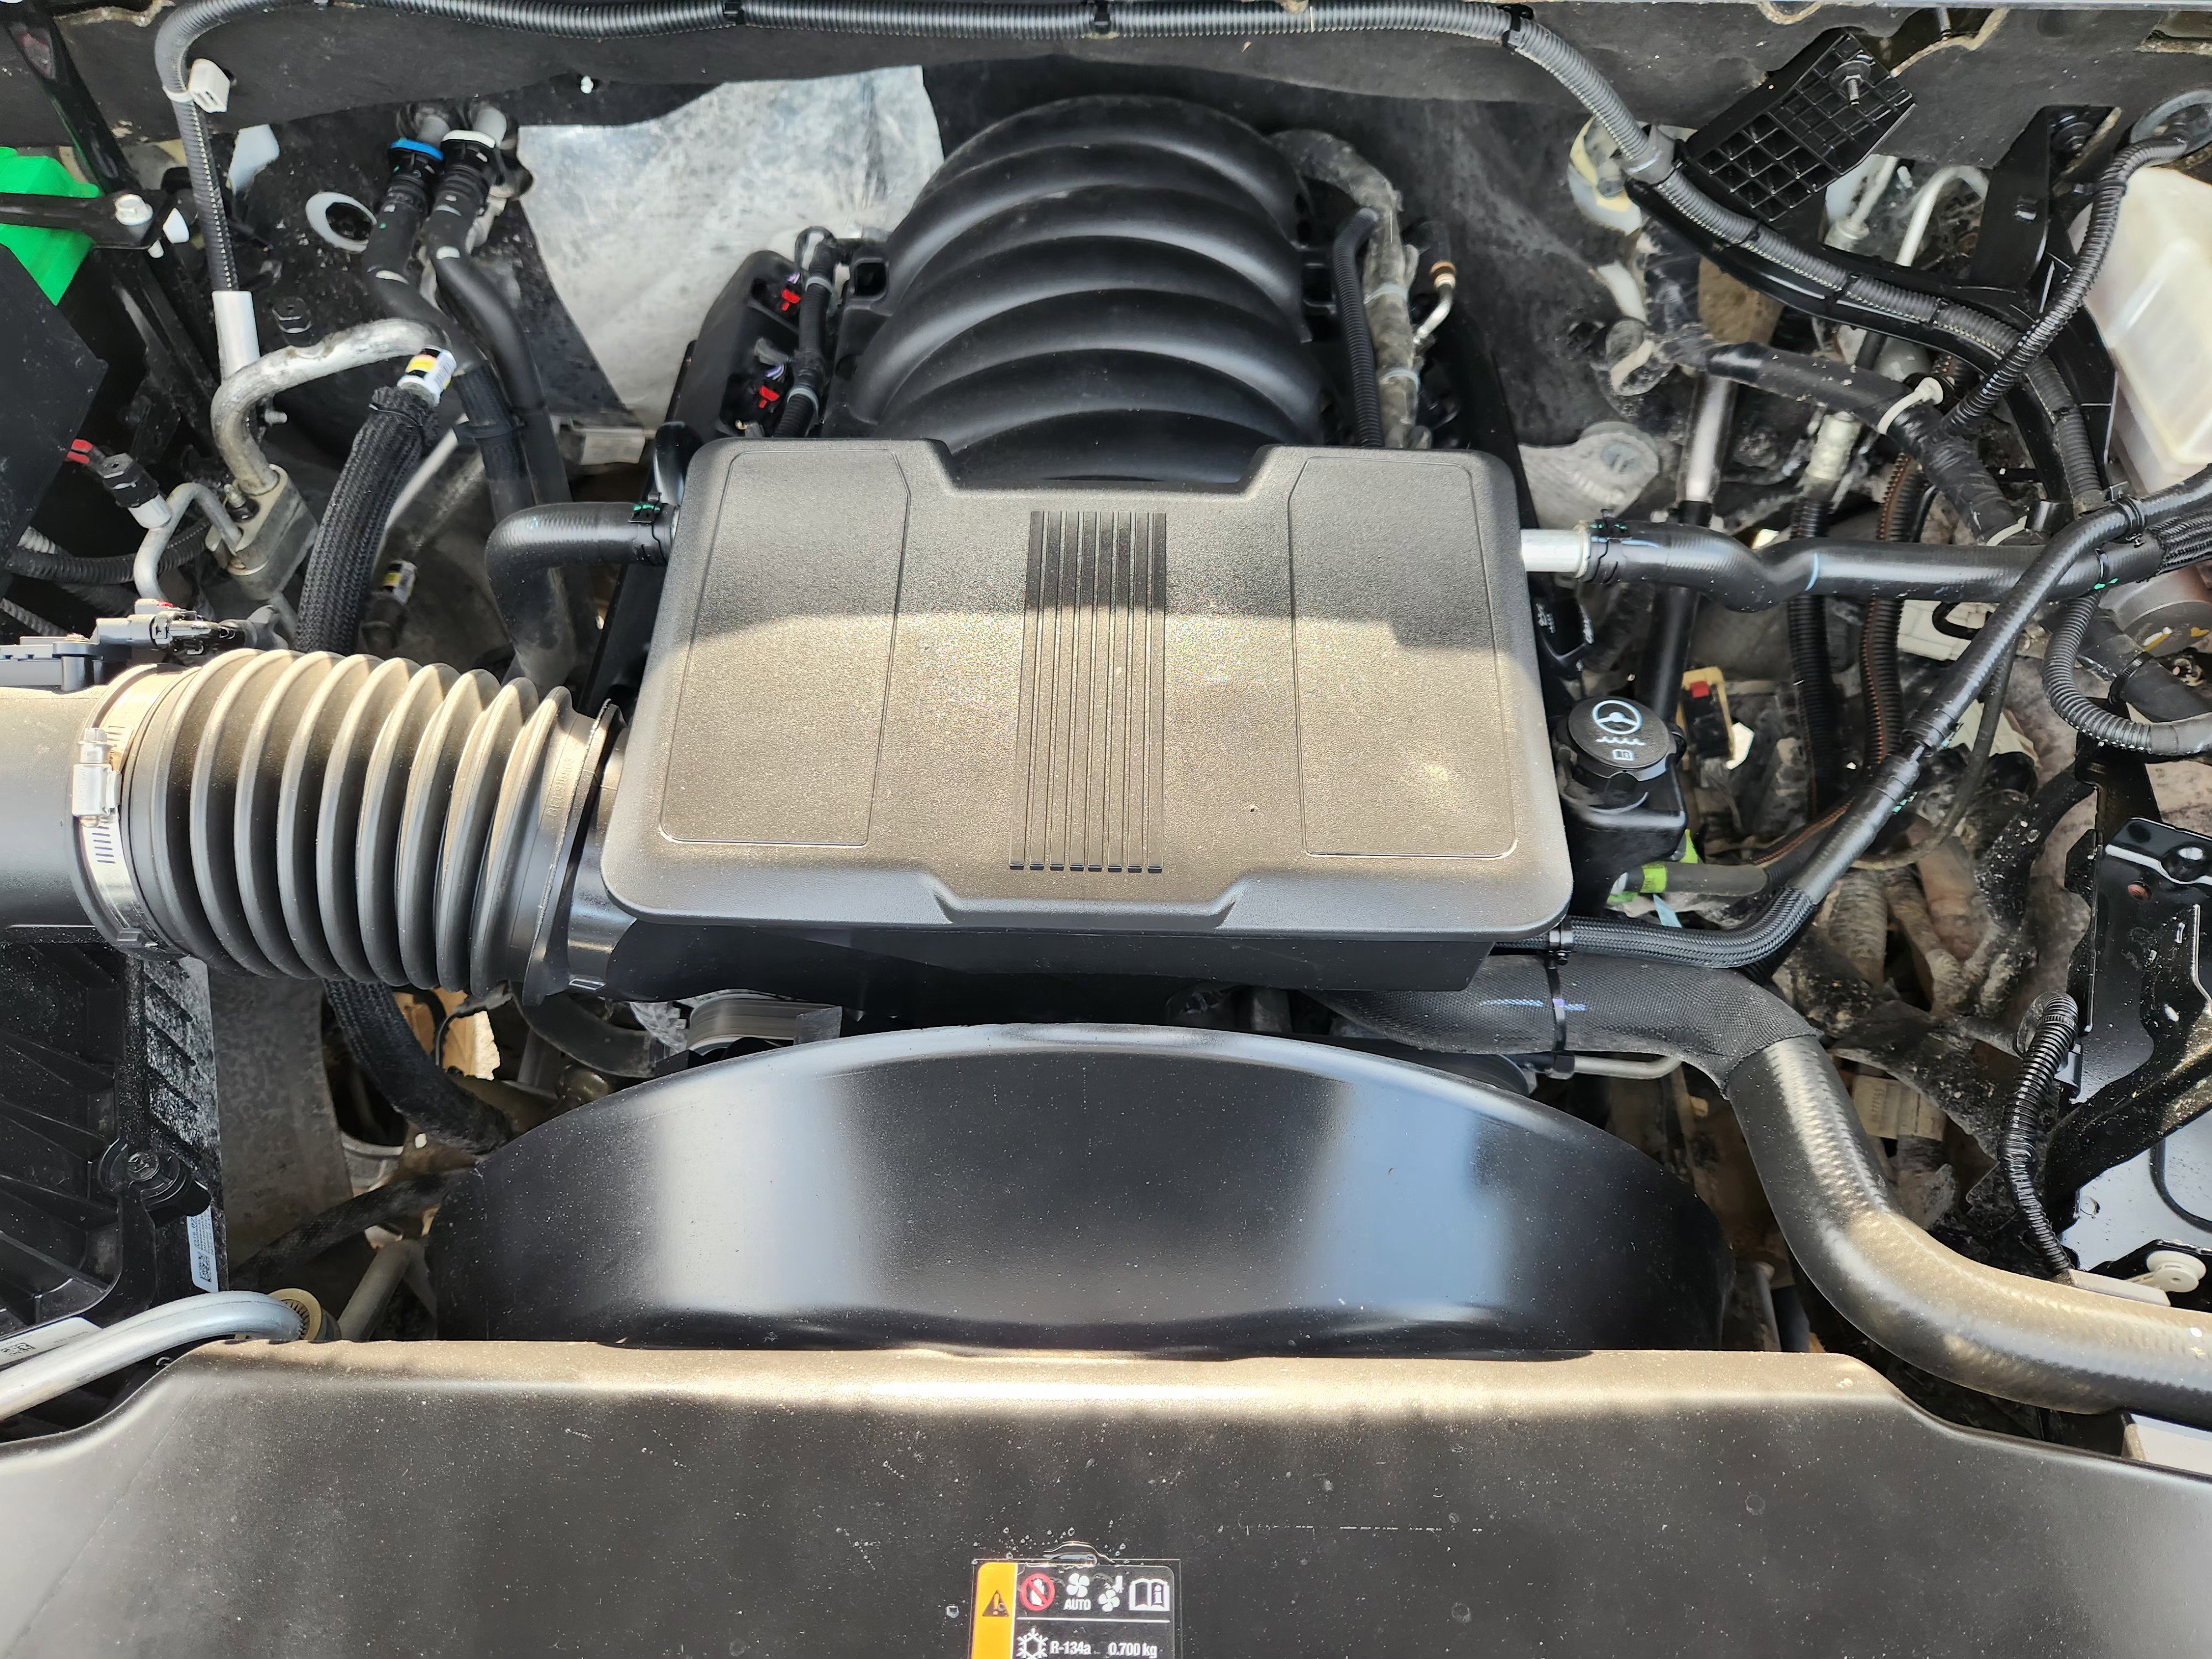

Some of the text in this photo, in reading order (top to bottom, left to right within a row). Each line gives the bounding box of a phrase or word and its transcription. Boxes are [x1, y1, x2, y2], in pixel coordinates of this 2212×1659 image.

[1063, 1599, 1092, 1611] AUTO
[1050, 1641, 1158, 1659] R-134a 0.700 kg
